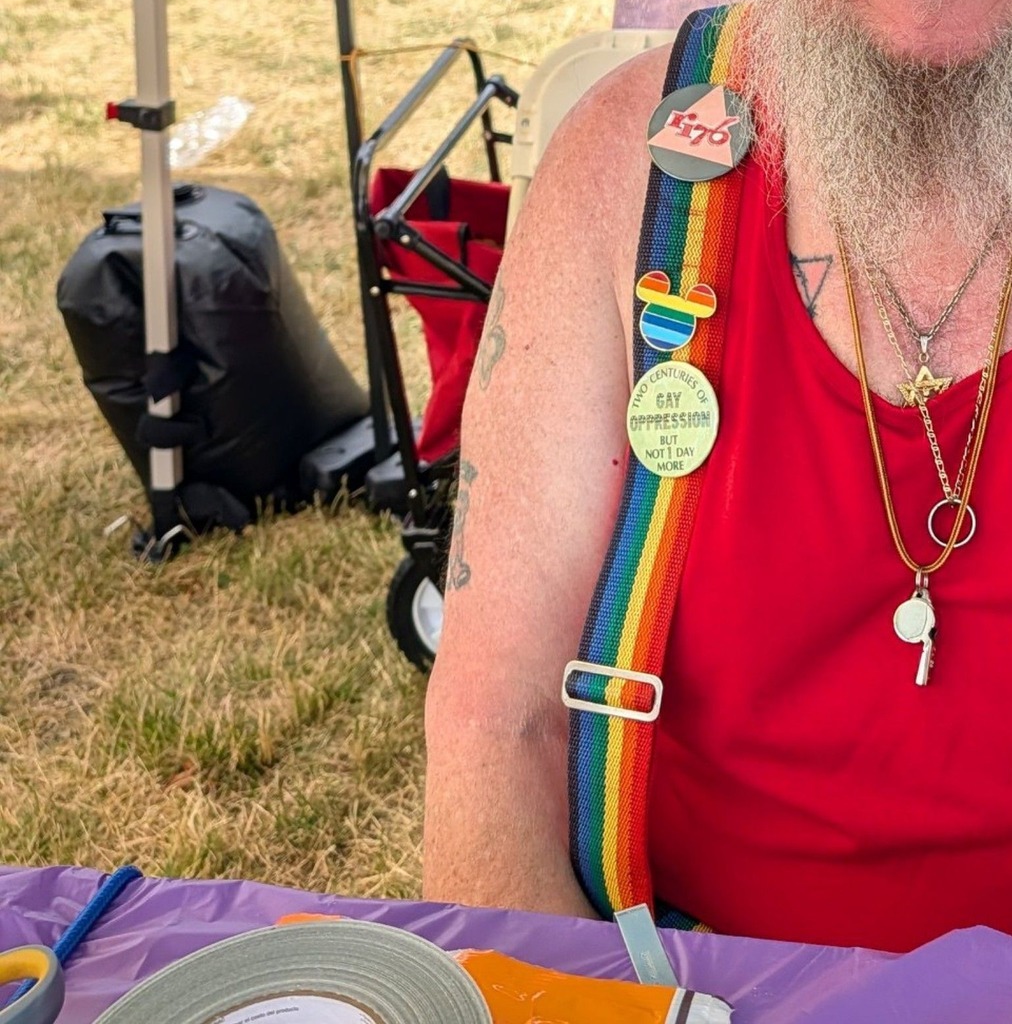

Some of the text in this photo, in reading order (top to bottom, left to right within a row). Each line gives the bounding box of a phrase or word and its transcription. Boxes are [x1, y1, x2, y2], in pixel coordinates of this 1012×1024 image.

[632, 367, 709, 409] TWO CENTURIES OF
[655, 392, 682, 409] GAY
[630, 410, 711, 432] OPPRESSION
[660, 435, 678, 446] BUT
[645, 448, 665, 459] NOT
[676, 447, 695, 457] DAY
[656, 460, 685, 472] MORE
